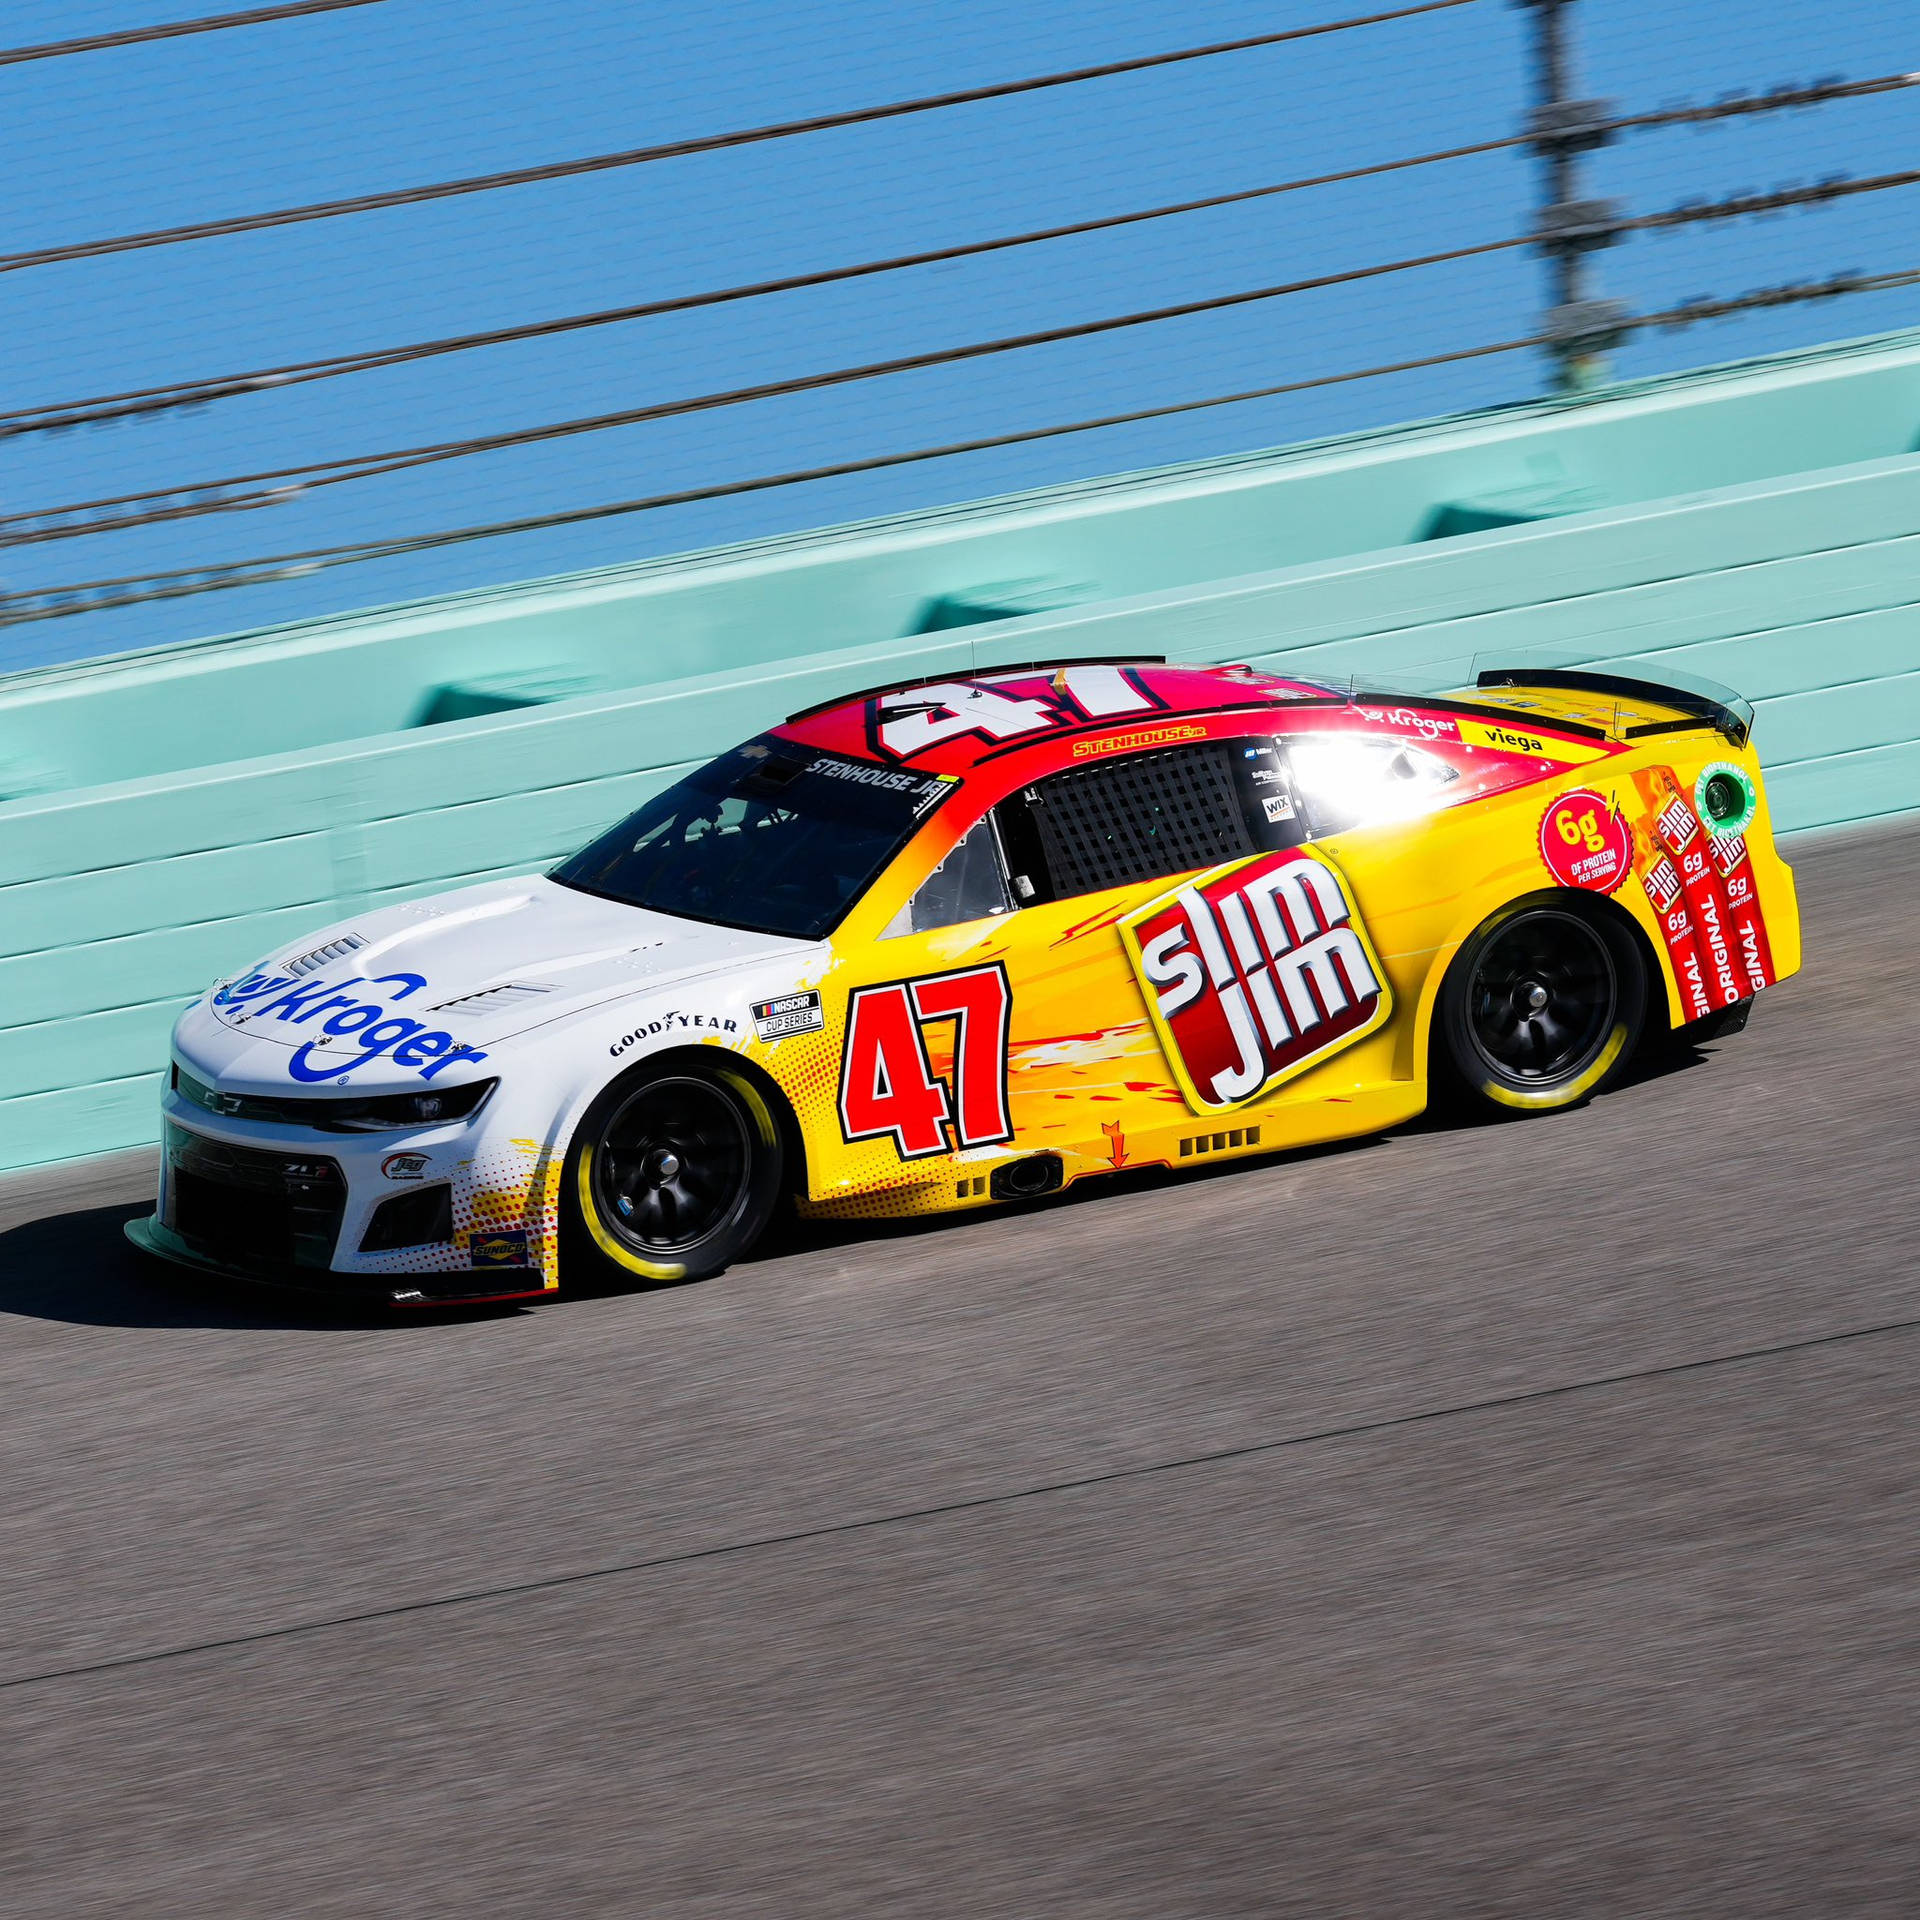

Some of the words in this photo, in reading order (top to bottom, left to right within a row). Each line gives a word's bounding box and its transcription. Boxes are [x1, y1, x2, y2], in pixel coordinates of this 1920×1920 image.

[876, 664, 1156, 757] 47
[1388, 708, 1456, 740] Kroger
[1073, 725, 1191, 757] STENHOUSE
[1484, 727, 1544, 752] viega
[804, 758, 919, 792] STENHOUSE
[1266, 797, 1289, 814] WIX
[1555, 809, 1606, 852] 6g
[1570, 861, 1583, 877] OF
[1582, 848, 1617, 872] PROTEIN
[1578, 873, 1591, 885] PER
[1591, 862, 1617, 880] SERVING
[1683, 851, 1703, 873] 6g
[1685, 866, 1711, 887] PROTEIN
[1727, 876, 1748, 897] 6g
[1728, 893, 1754, 910] PROTEIN
[1667, 909, 1687, 931] 6g
[1669, 924, 1694, 945] PROTEIN
[1700, 894, 1739, 1004] ORIGINAL
[774, 995, 811, 1014] NASCAR
[253, 973, 489, 1083] Kroger
[766, 1019, 784, 1032] CUP
[784, 1011, 814, 1029] SERIES
[838, 961, 1014, 1161] 47
[474, 1241, 527, 1256] SUNOCO
